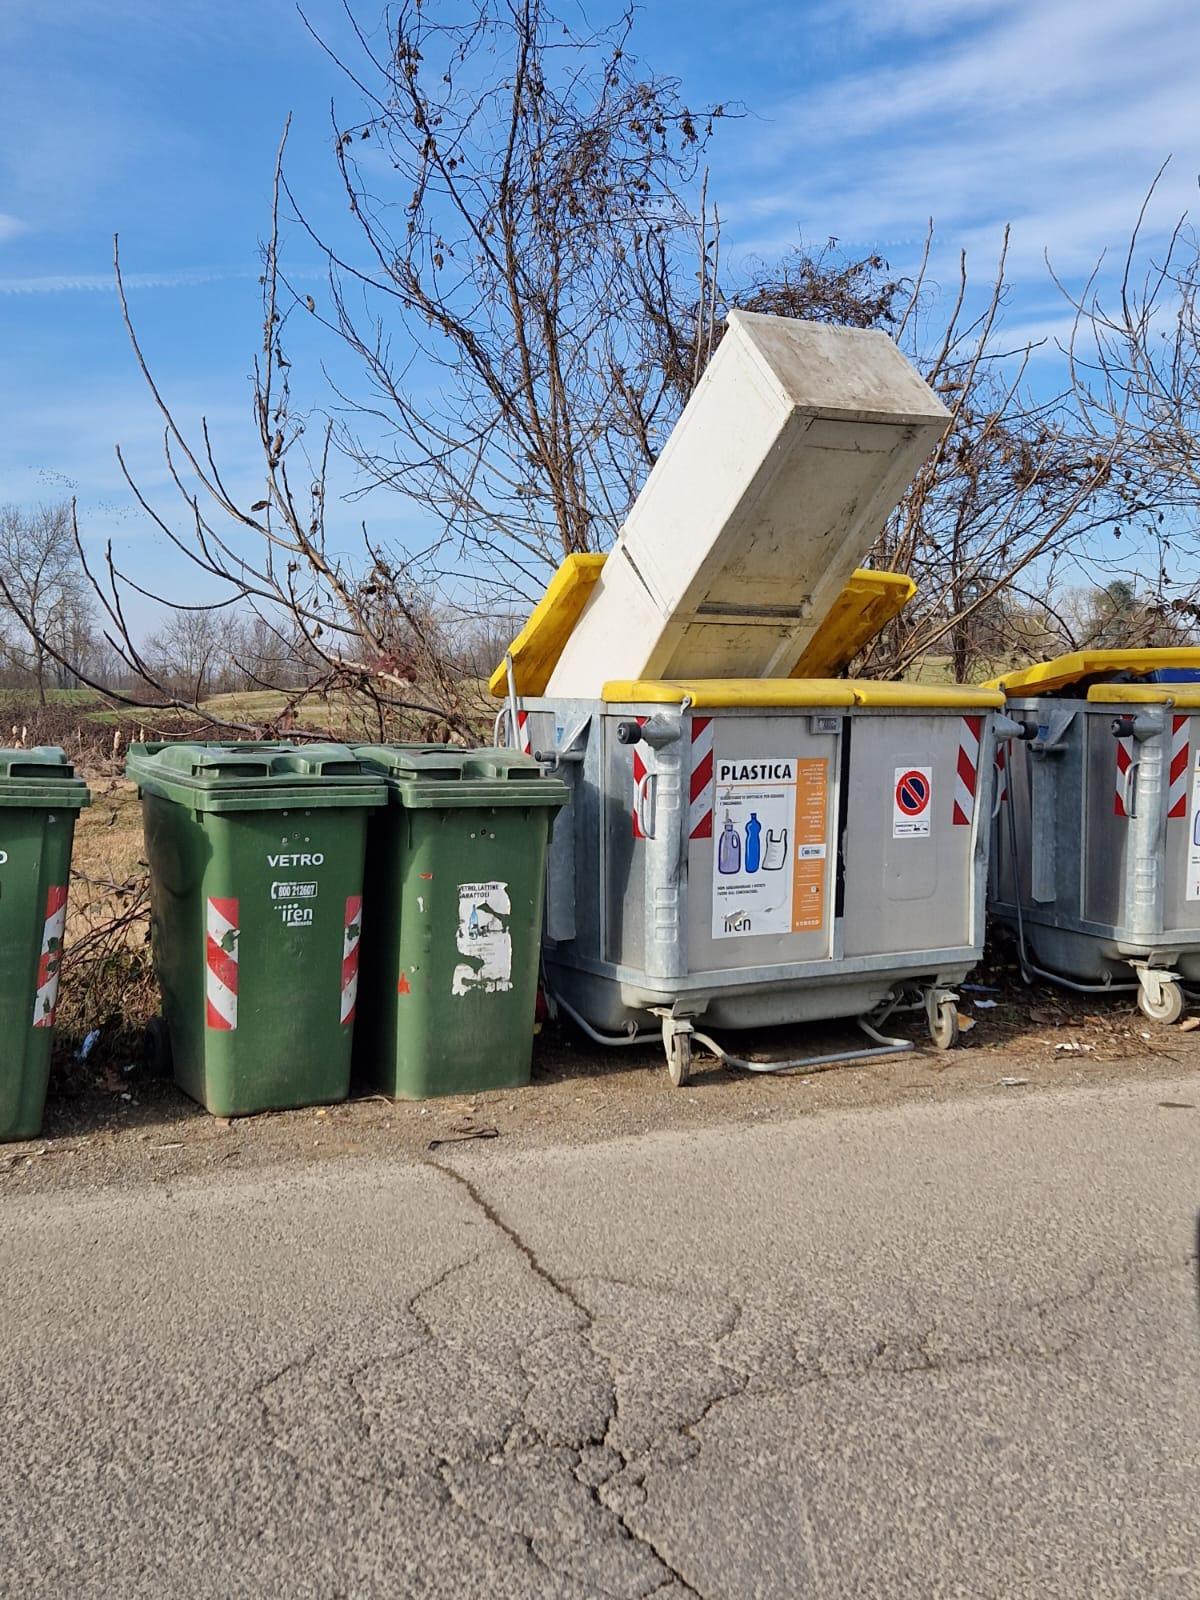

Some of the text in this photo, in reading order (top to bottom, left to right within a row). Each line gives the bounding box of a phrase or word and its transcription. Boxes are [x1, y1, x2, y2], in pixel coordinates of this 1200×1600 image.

[720, 764, 792, 781] PLASTICA
[266, 853, 324, 867] VETRO
[278, 884, 315, 897] 800 212607
[282, 905, 313, 921] iren
